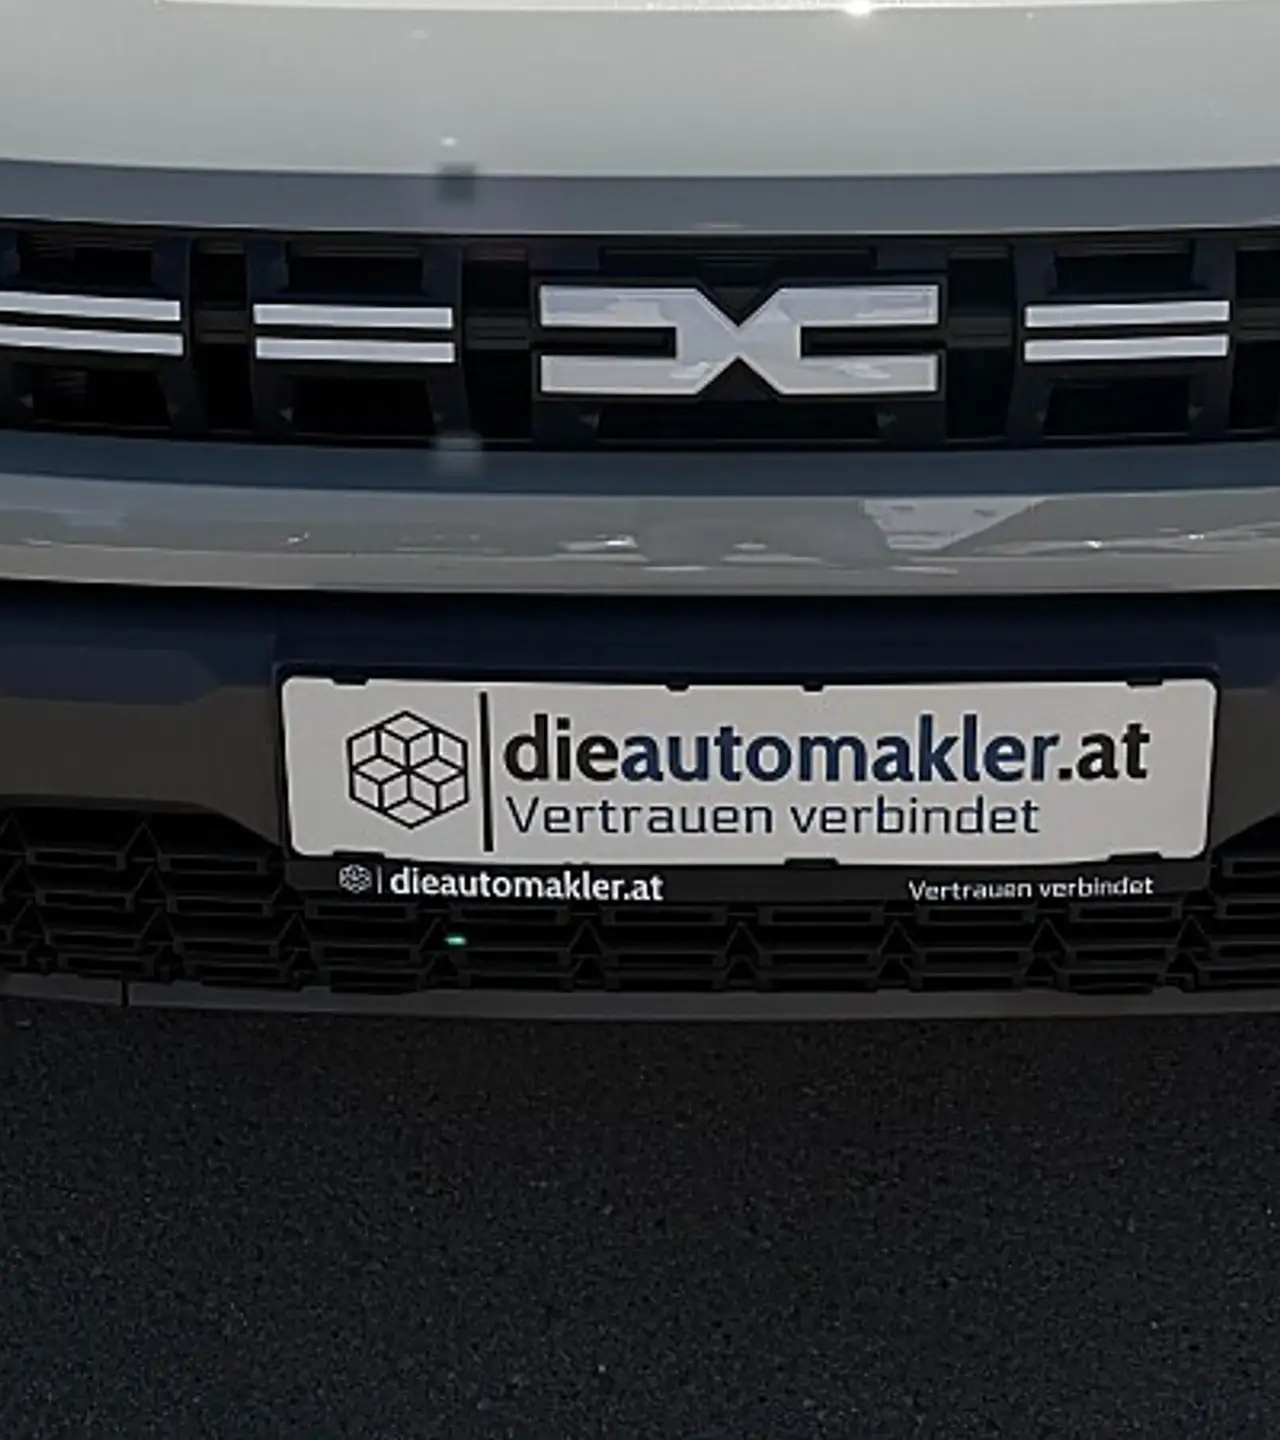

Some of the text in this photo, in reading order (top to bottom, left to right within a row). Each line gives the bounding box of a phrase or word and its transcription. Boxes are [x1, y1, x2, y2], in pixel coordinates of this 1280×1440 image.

[503, 713, 1152, 782] dieautomakler.at
[505, 793, 1041, 835] Vertrauen verbindet
[389, 866, 665, 901] dieautomakler.at
[908, 876, 1155, 901] Vertrauen verbindet
